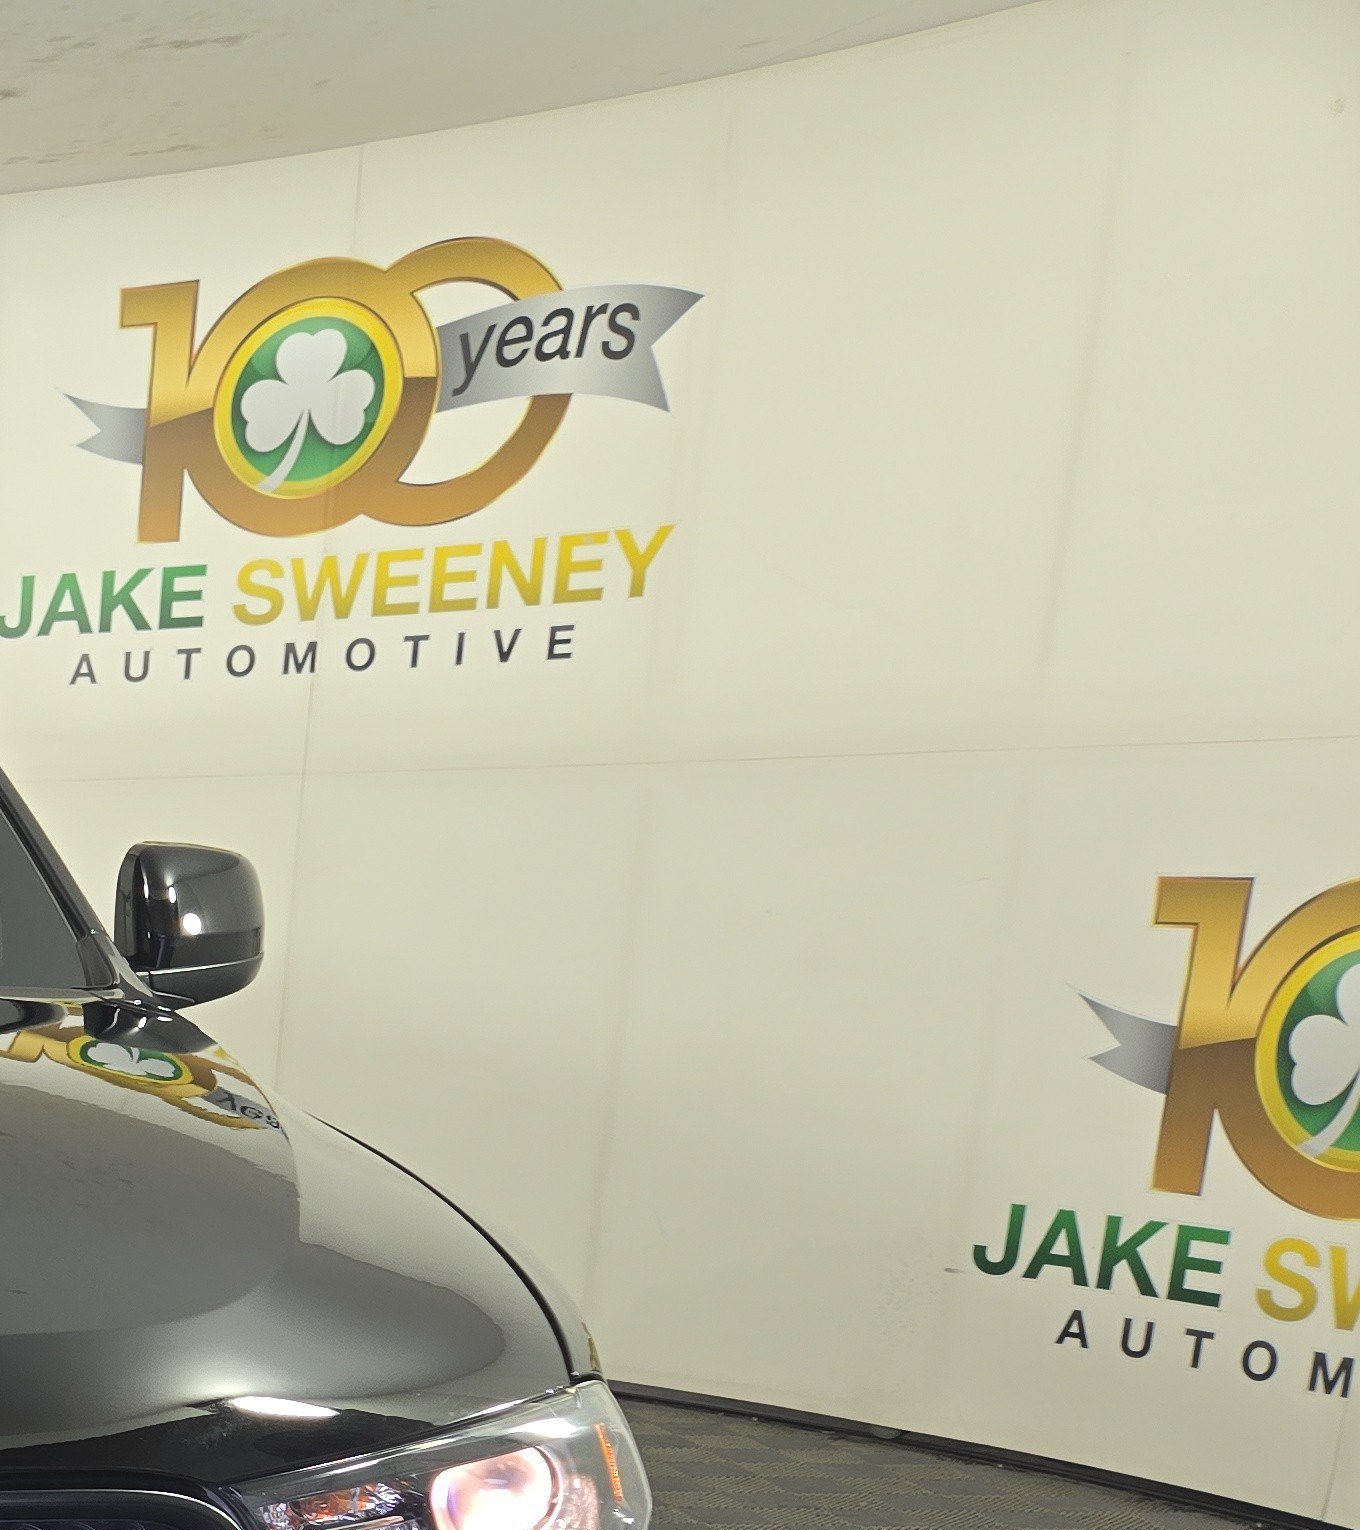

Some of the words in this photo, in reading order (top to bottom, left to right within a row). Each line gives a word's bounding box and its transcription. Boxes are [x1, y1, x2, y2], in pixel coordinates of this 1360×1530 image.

[118, 236, 573, 544] 100
[451, 300, 640, 397] years
[232, 524, 676, 626] SWEENEY
[69, 625, 576, 687] AUTOMOTIVE
[973, 1203, 1231, 1309] JAKE
